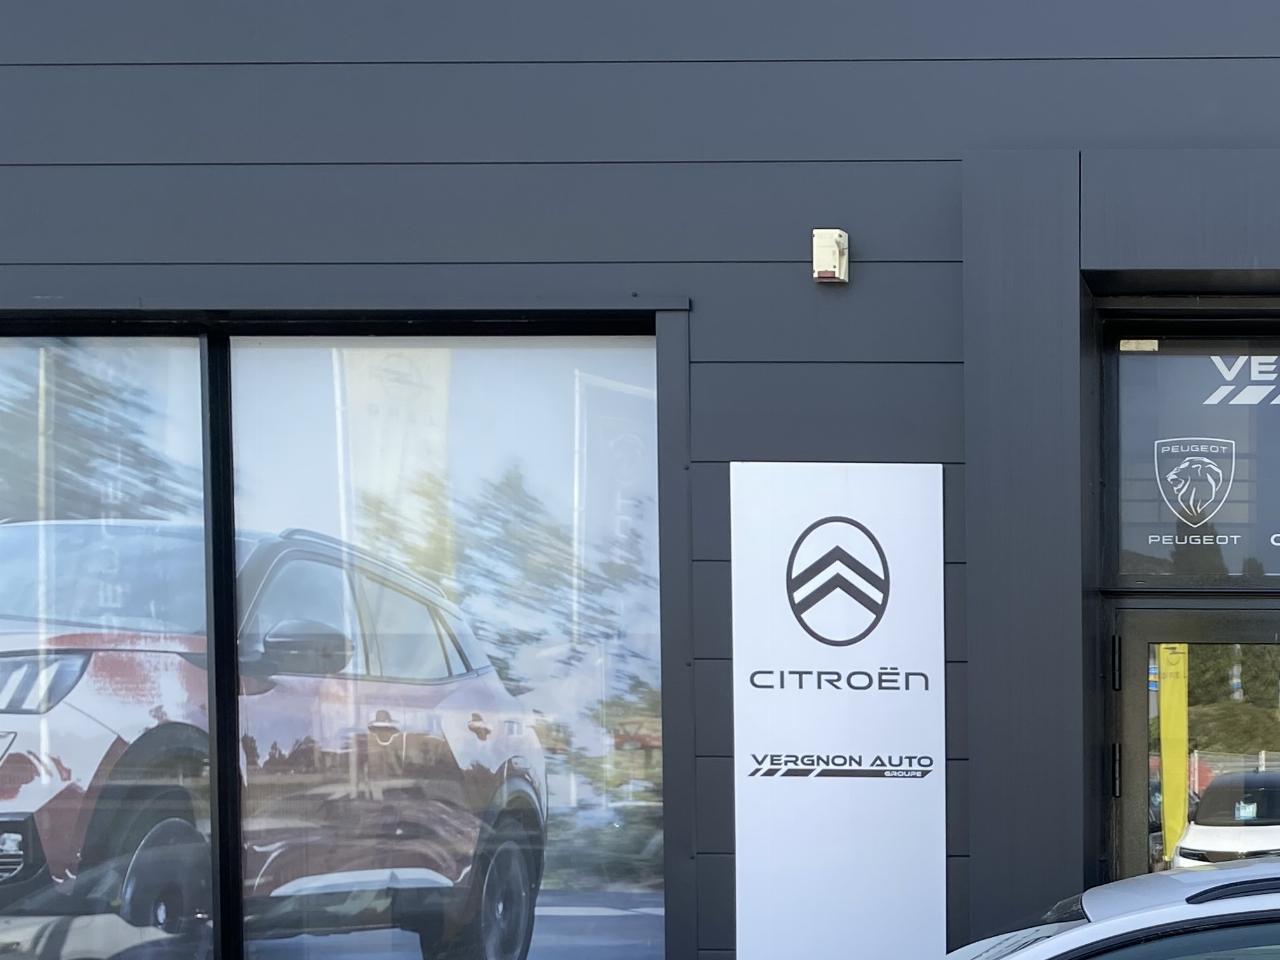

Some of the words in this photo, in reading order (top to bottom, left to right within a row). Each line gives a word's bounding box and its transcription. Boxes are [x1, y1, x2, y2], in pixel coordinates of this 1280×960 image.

[1161, 444, 1229, 455] PEUGEOT
[1148, 534, 1242, 545] PEUGEOT
[749, 666, 930, 691] CITROËN
[750, 754, 863, 768] VERGNON
[869, 755, 934, 768] AUTO
